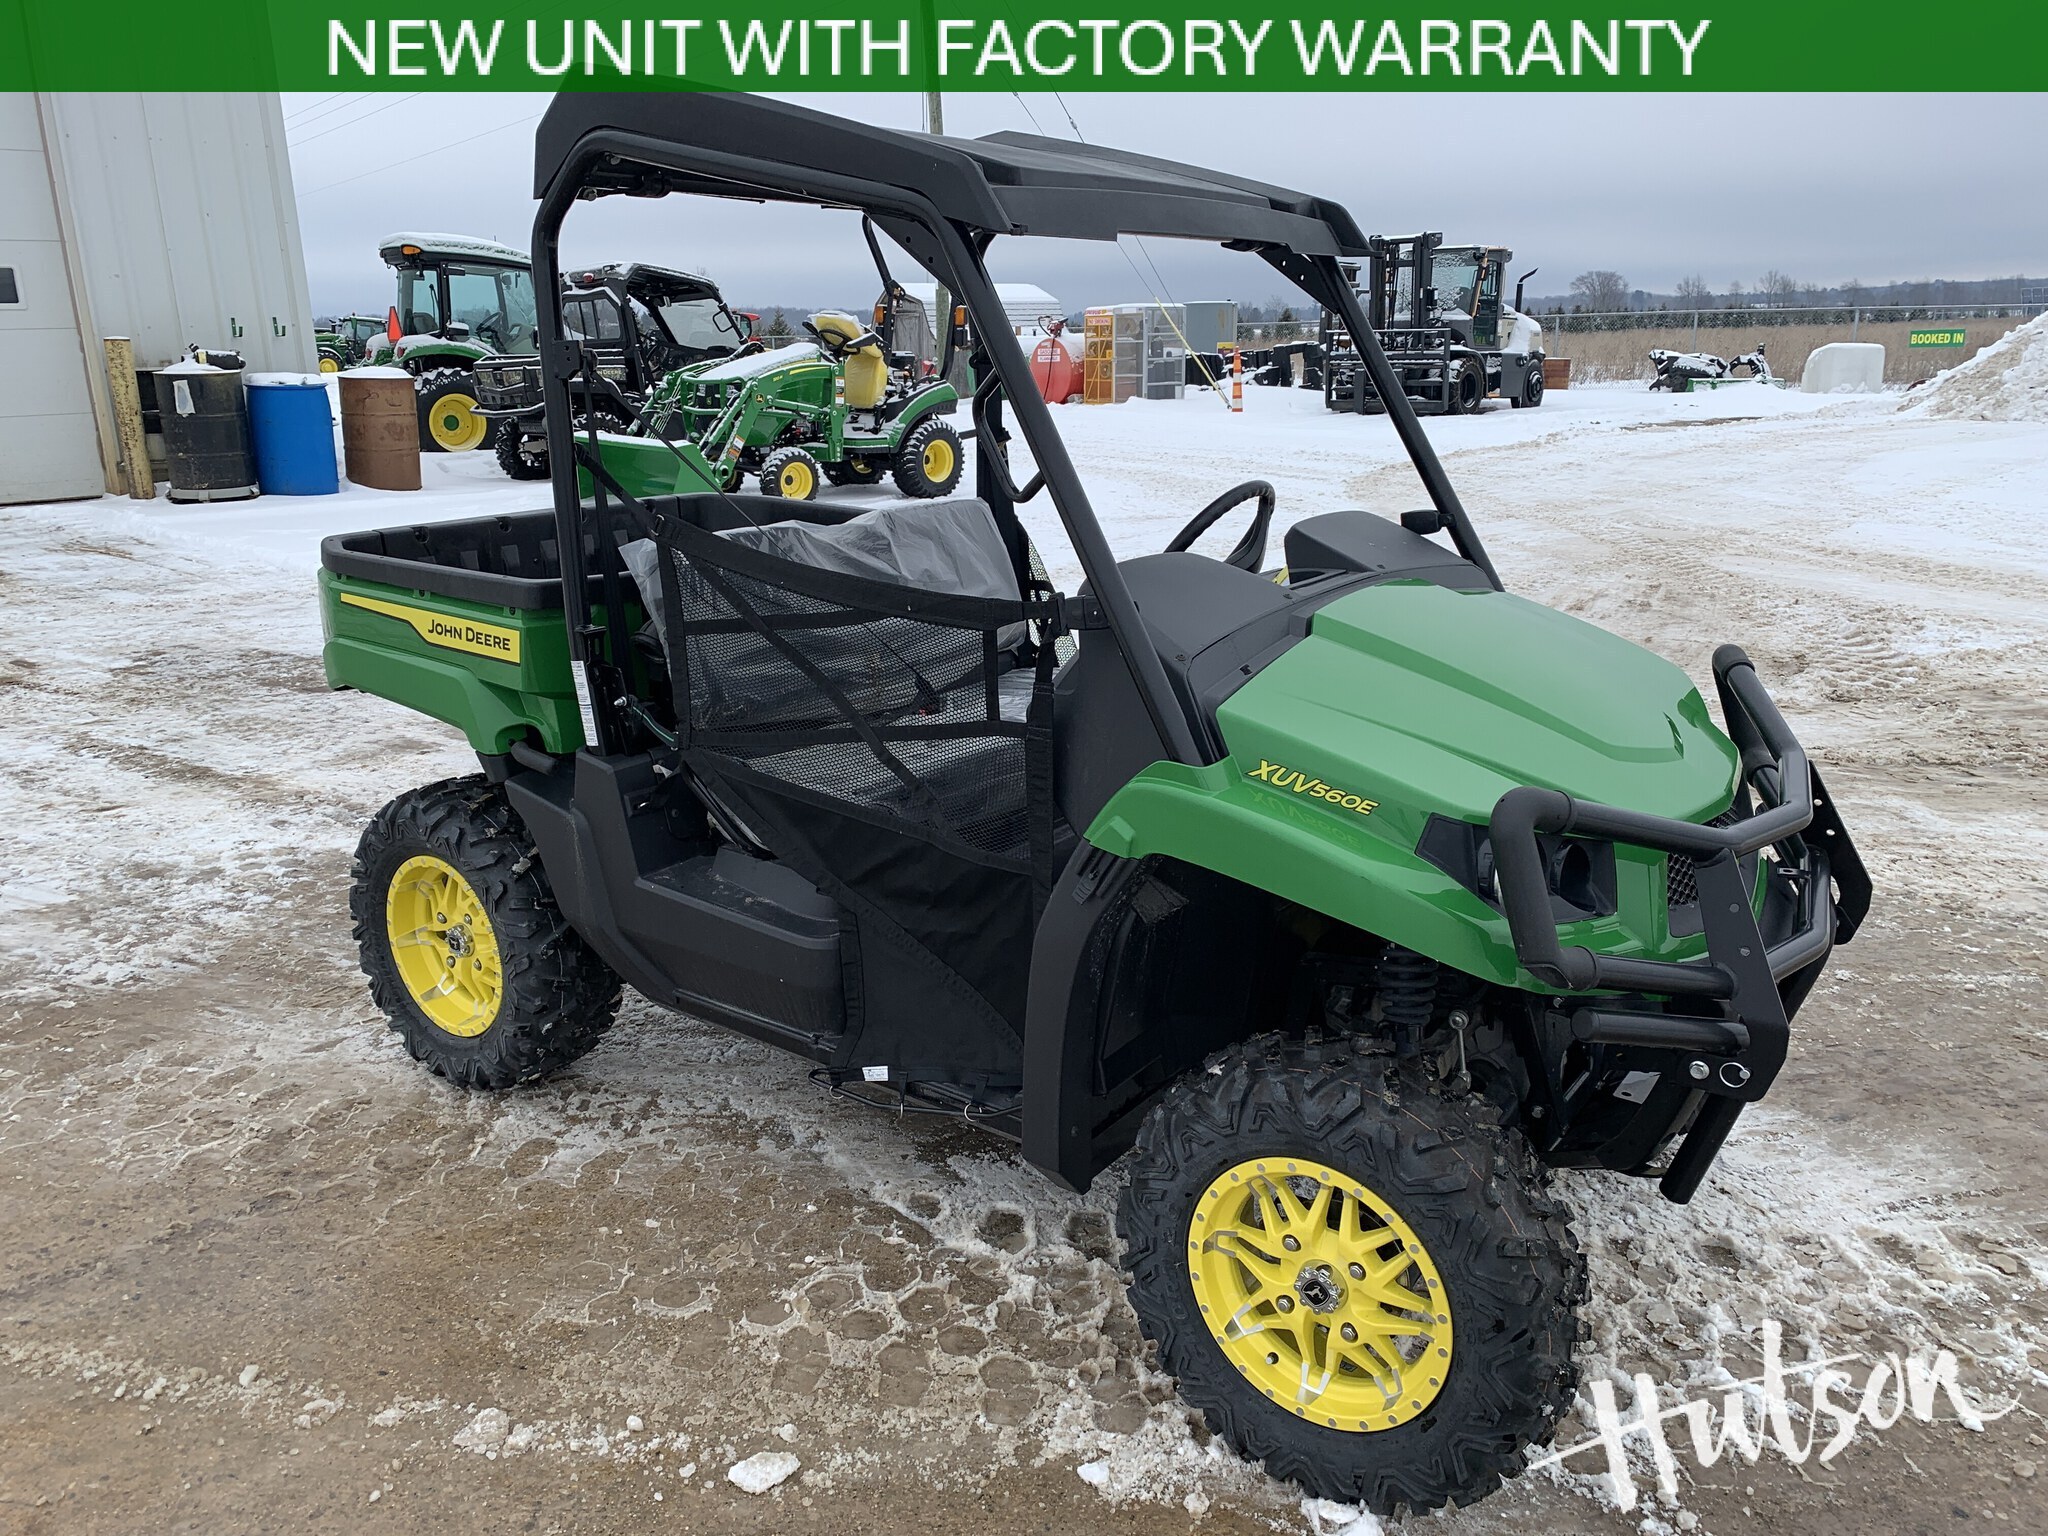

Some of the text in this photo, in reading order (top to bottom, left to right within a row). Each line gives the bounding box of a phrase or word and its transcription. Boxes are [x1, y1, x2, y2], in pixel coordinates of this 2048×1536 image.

[1911, 333, 1964, 344] BOOKED IN
[428, 619, 511, 651] JOHN DEERE
[1245, 759, 1380, 816] XUV560E
